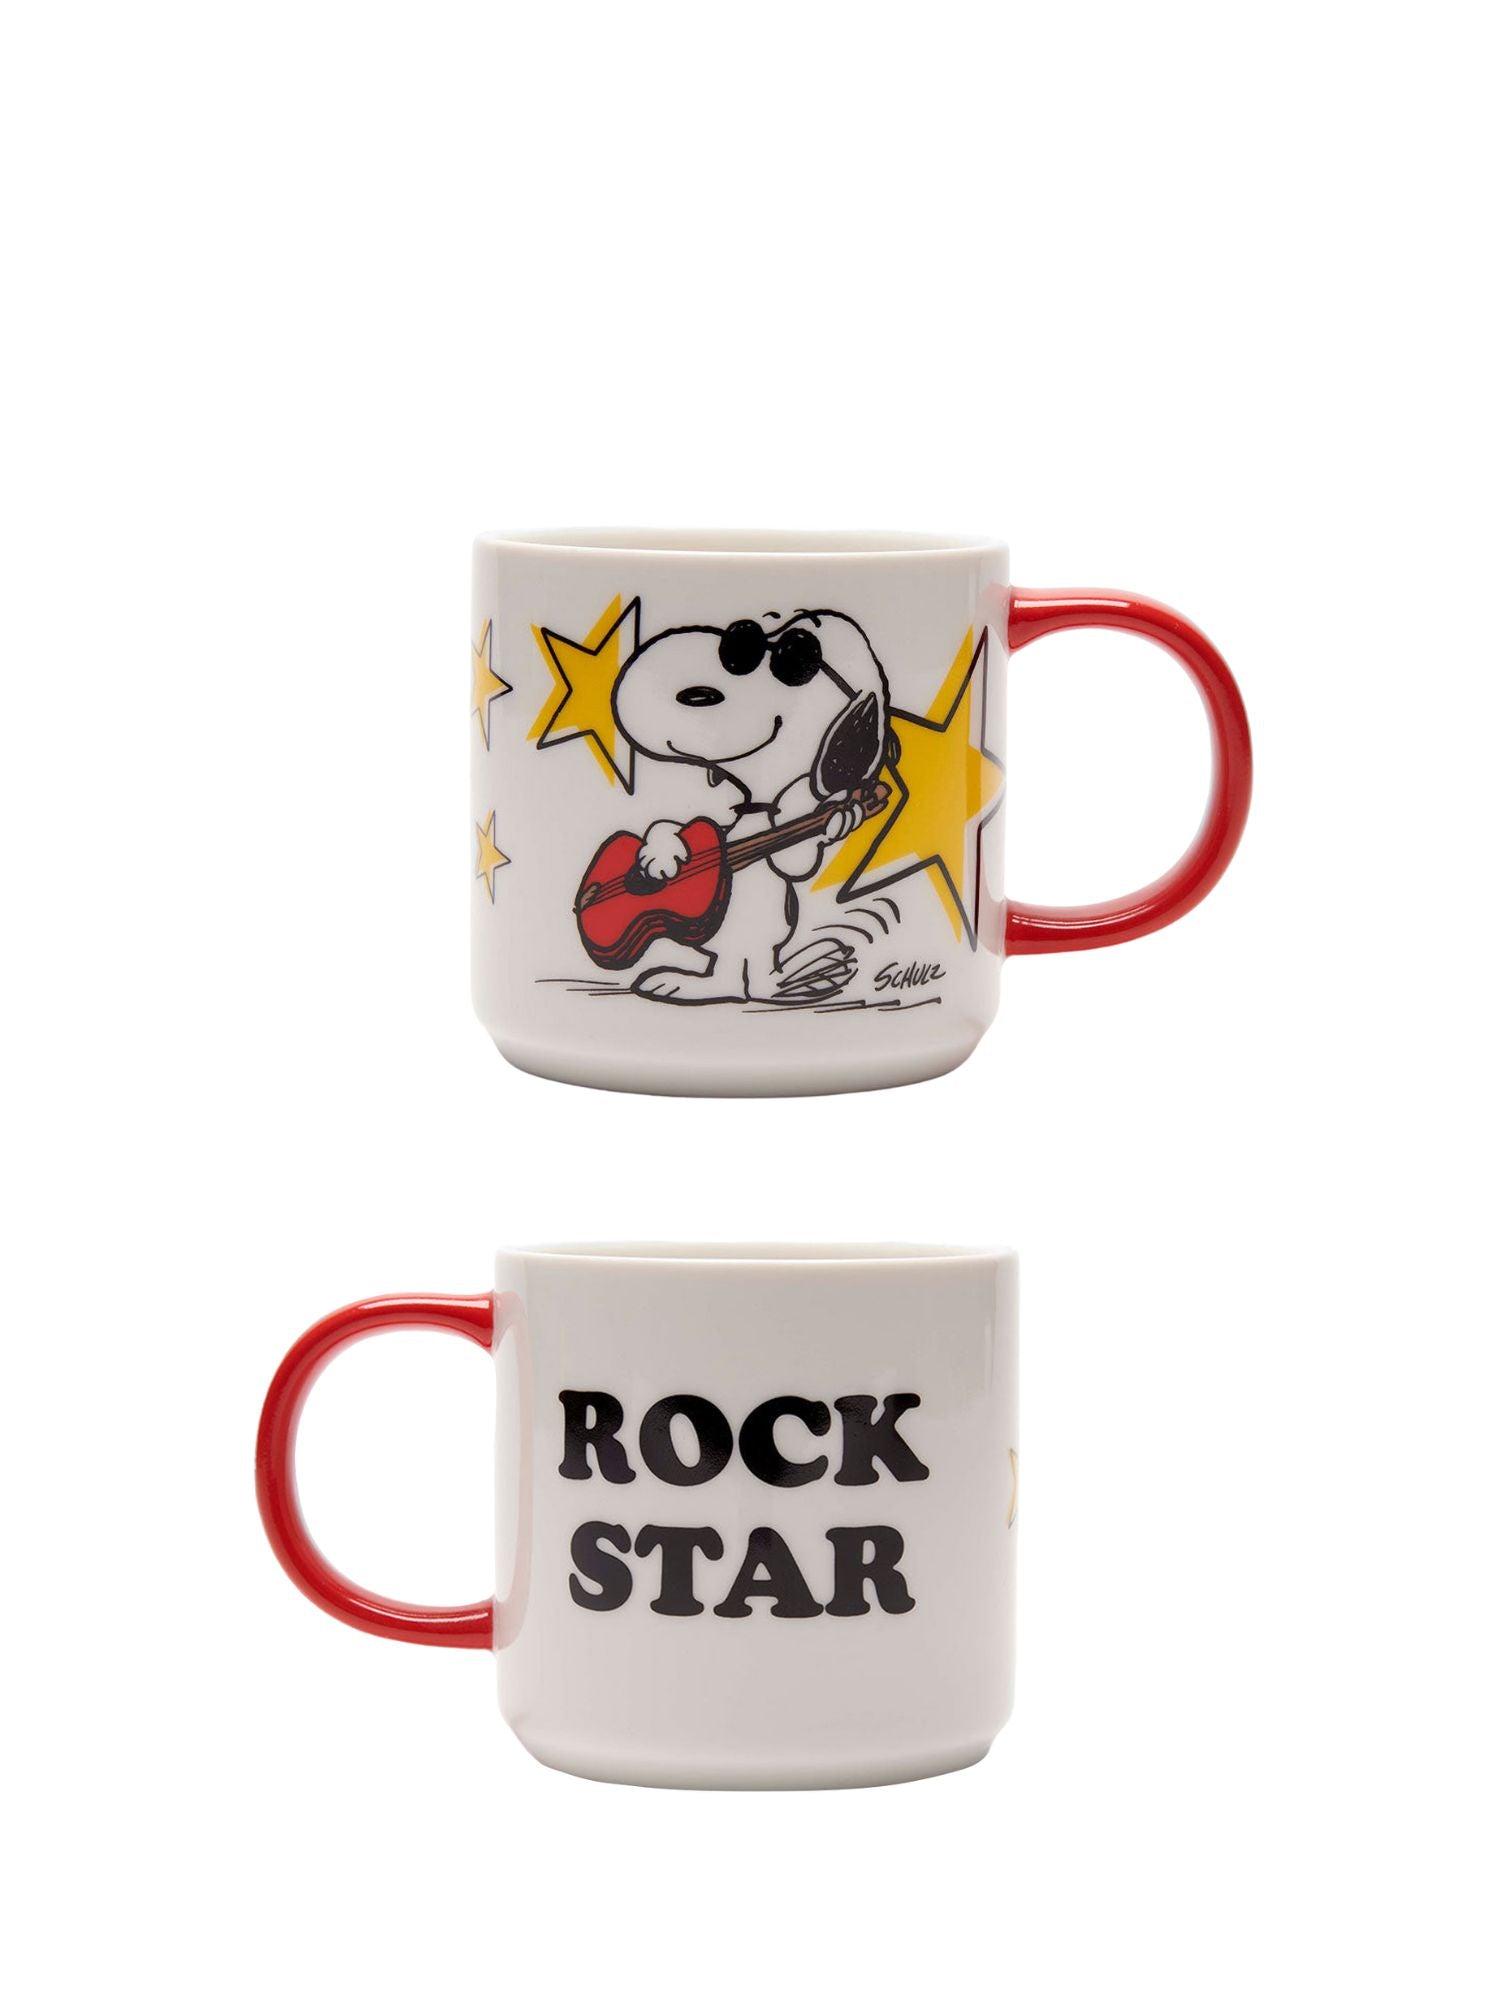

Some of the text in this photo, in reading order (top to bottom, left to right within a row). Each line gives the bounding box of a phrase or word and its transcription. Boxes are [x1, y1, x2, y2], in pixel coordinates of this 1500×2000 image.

[873, 961, 947, 992] SCHULZ
[558, 1389, 930, 1489] ROCK
[568, 1520, 916, 1619] STAR
